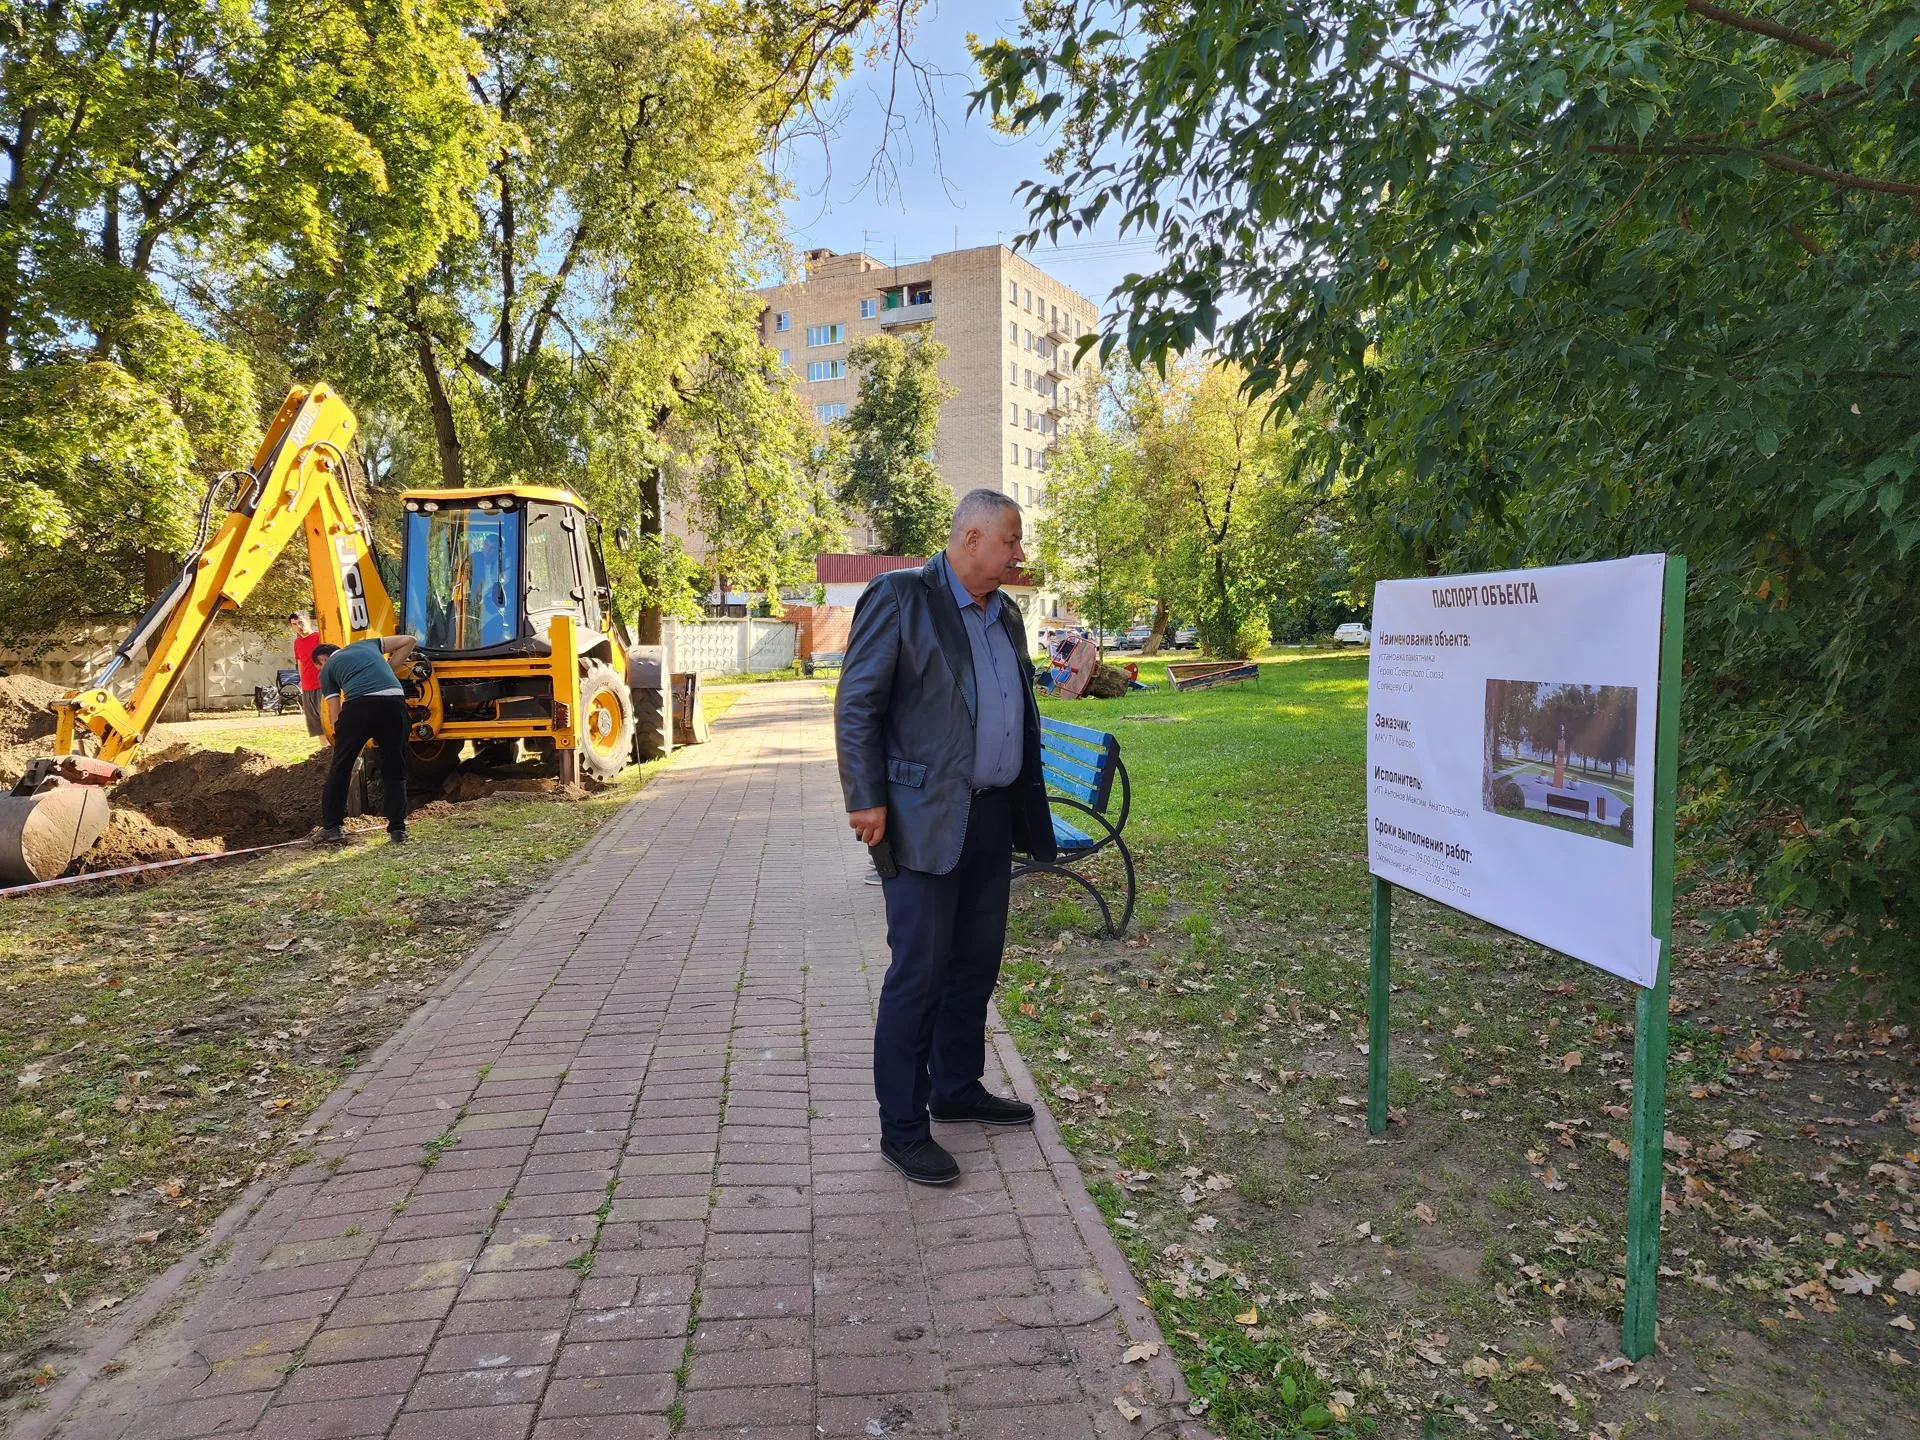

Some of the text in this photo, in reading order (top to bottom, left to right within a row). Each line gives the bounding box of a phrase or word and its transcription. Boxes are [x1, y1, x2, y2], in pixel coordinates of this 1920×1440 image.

[333, 535, 370, 631] JCB
[1432, 582, 1539, 608] ПАСПОРТ ОБЪЕКТА
[1379, 630, 1472, 647] Наименование объекта:
[1375, 713, 1411, 732] Заказчик:
[1374, 765, 1423, 790] Исполнитель:
[1428, 799, 1469, 819] Анатольевич
[1374, 817, 1473, 863] Сроки выполнения работ:
[1446, 865, 1460, 877] года
[1456, 885, 1471, 898] года
